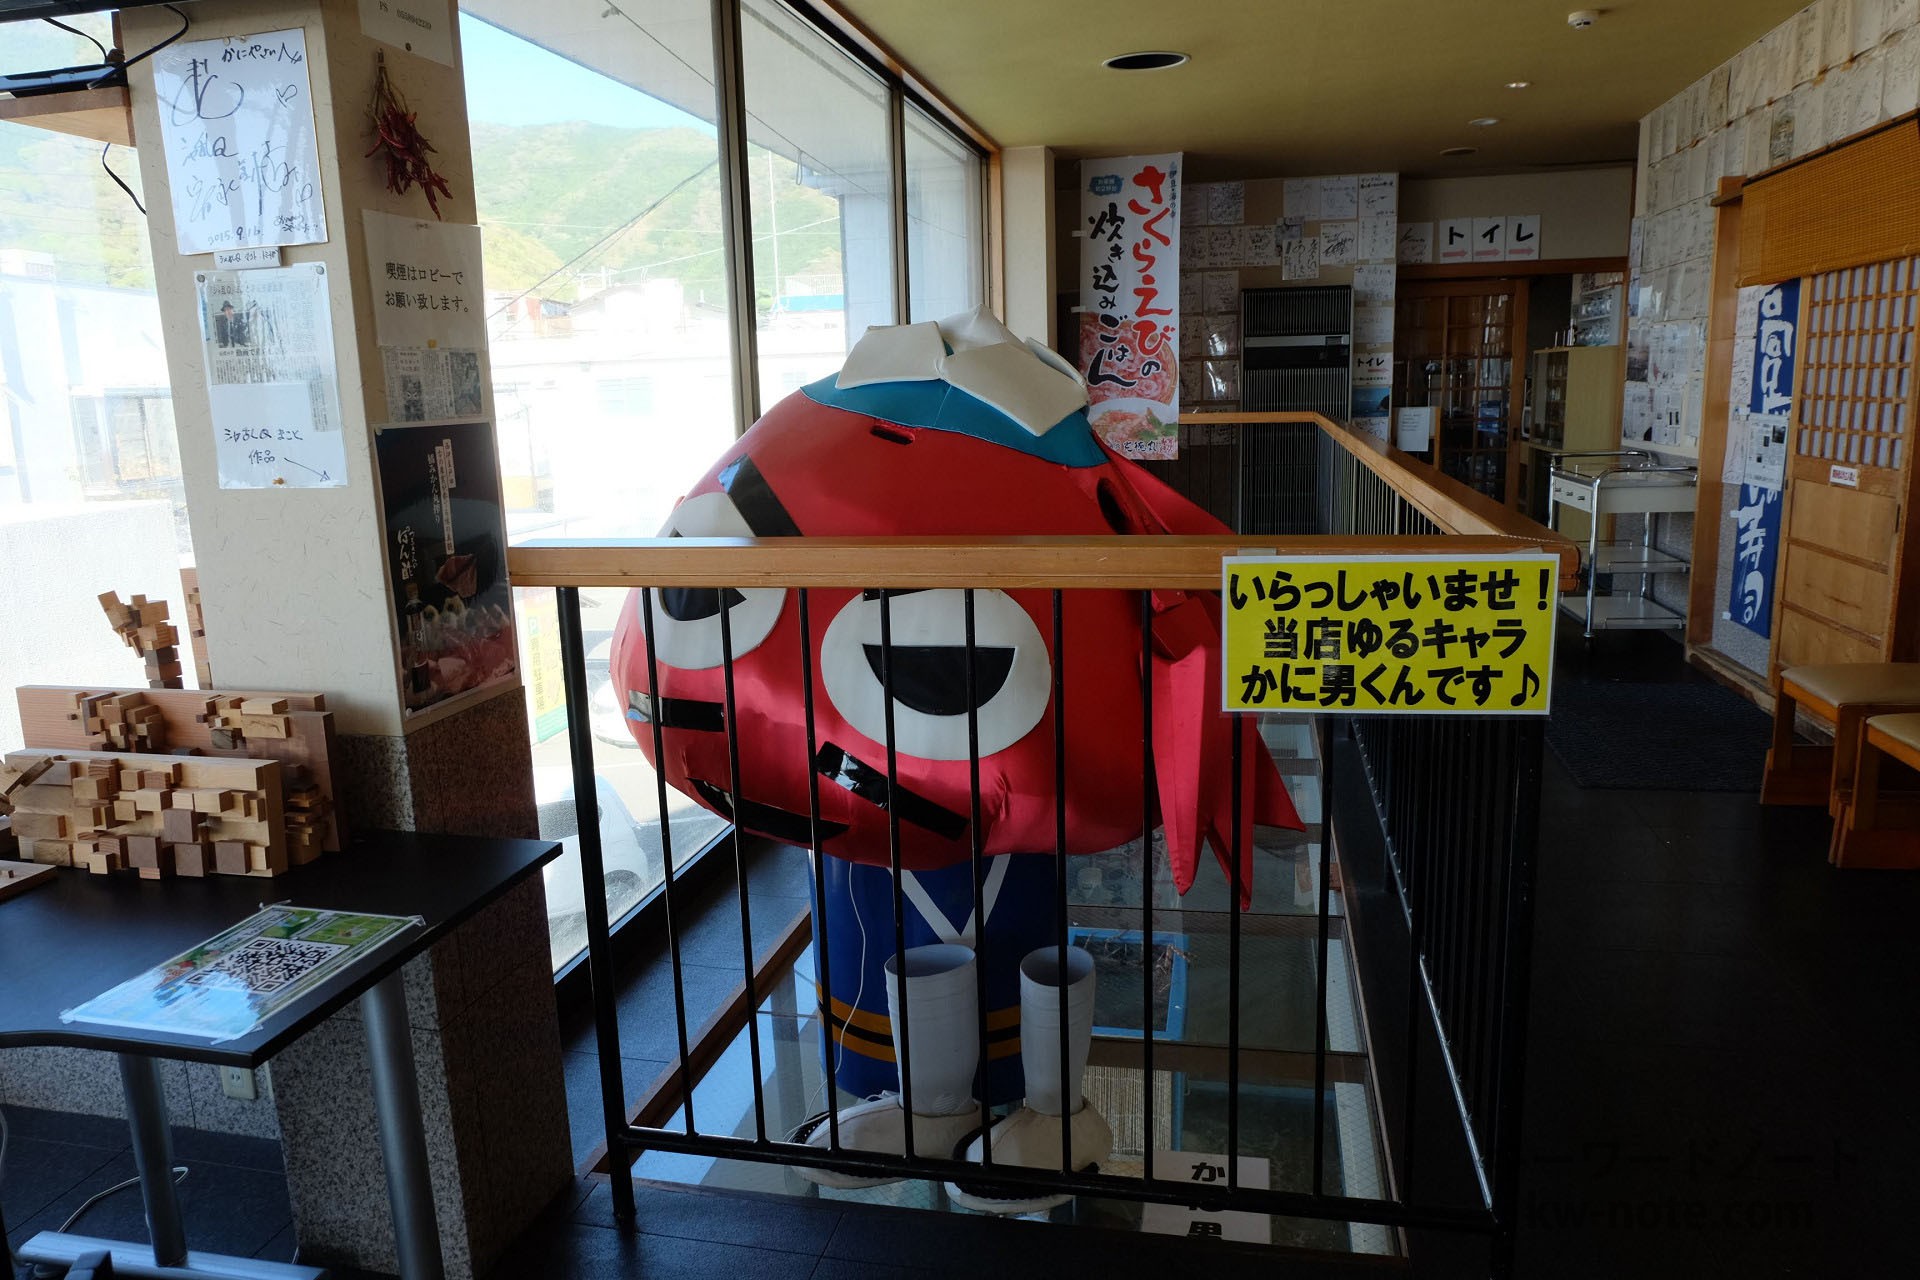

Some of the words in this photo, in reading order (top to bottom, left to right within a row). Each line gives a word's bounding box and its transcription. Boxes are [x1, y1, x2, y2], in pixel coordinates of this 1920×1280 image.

[1448, 223, 1534, 246] トイレ
[385, 262, 464, 285] 喫煙はロビーで
[1127, 165, 1176, 377] さくらえびの
[385, 290, 470, 314] お願い致します。
[1088, 202, 1136, 389] 炊き込みごはん
[1357, 357, 1385, 367] トイレ
[248, 450, 275, 464] 作品
[397, 525, 413, 580] ぽん酢
[1230, 568, 1550, 611] いらっしゃいませ！
[1263, 616, 1527, 660] 当店ゆるキャラ
